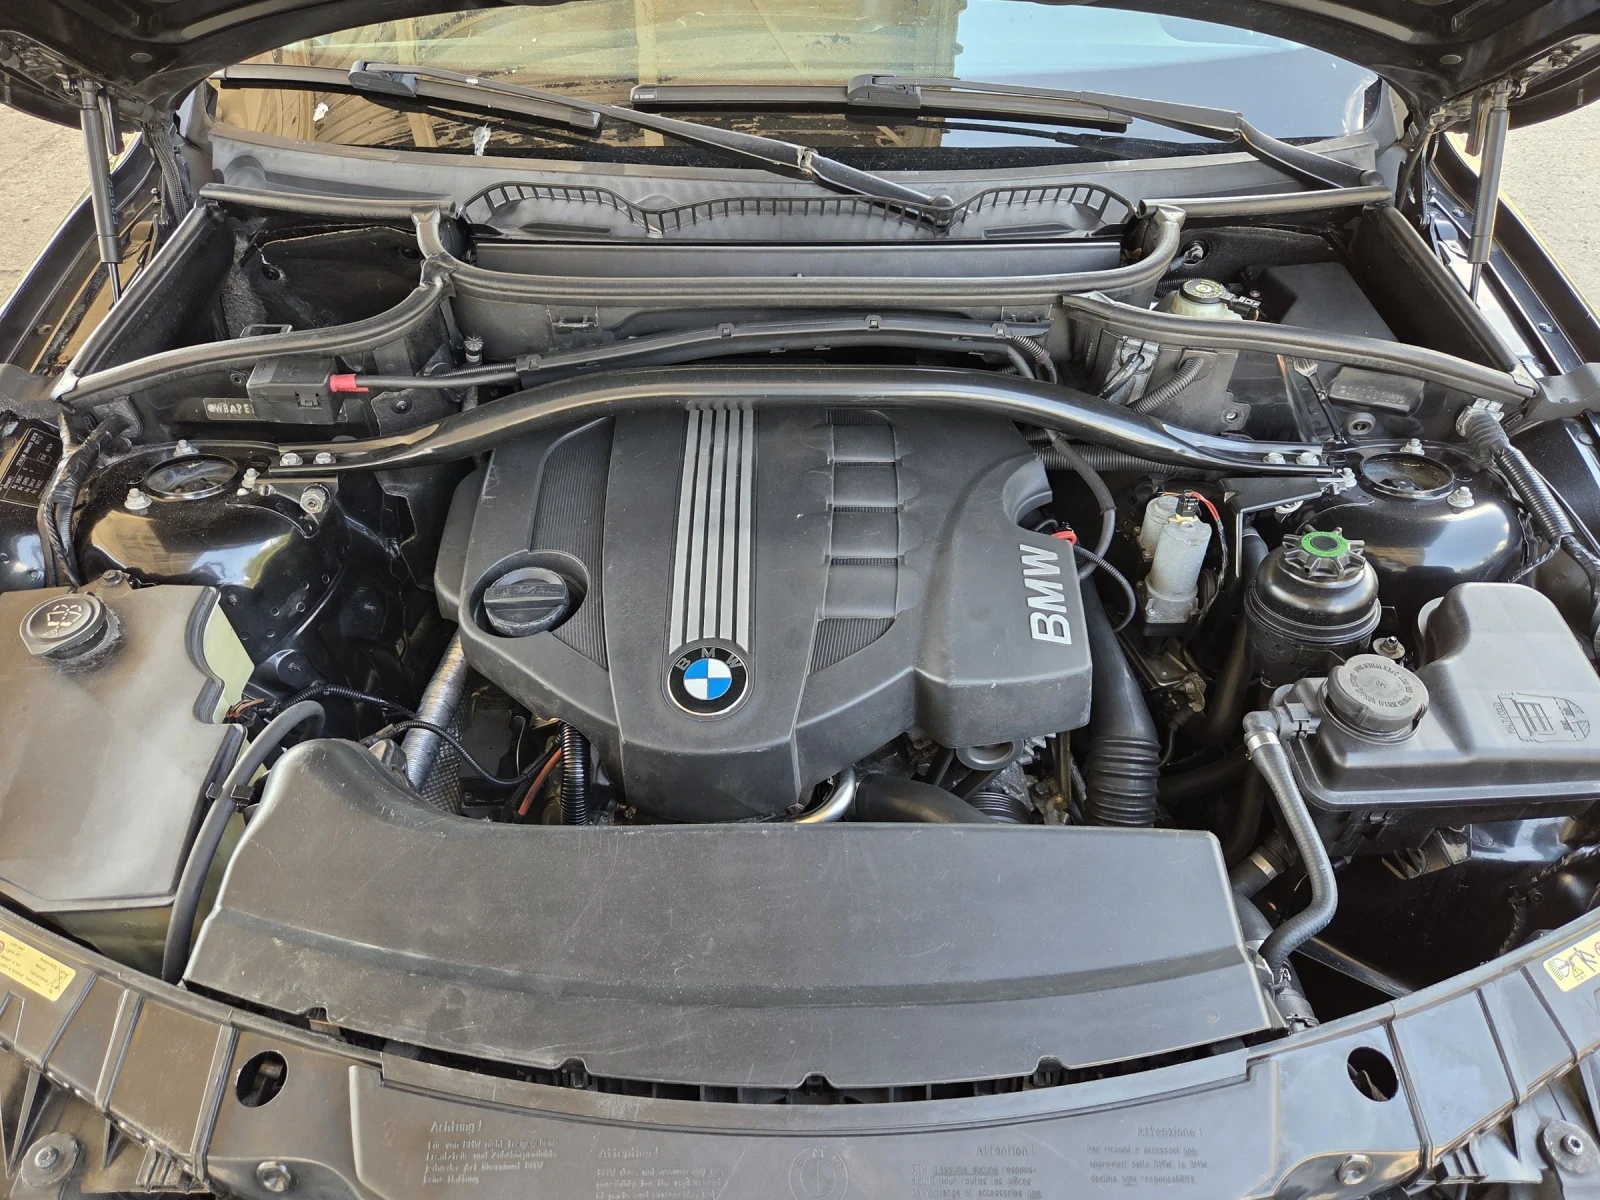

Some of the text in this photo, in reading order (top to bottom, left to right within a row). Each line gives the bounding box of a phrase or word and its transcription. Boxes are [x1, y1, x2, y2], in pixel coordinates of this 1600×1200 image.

[1020, 544, 1072, 645] BMW
[675, 647, 742, 671] BMW
[430, 1121, 475, 1134] Achtung
[1138, 1126, 1196, 1137] Attenzione
[976, 1145, 1028, 1157] Attention
